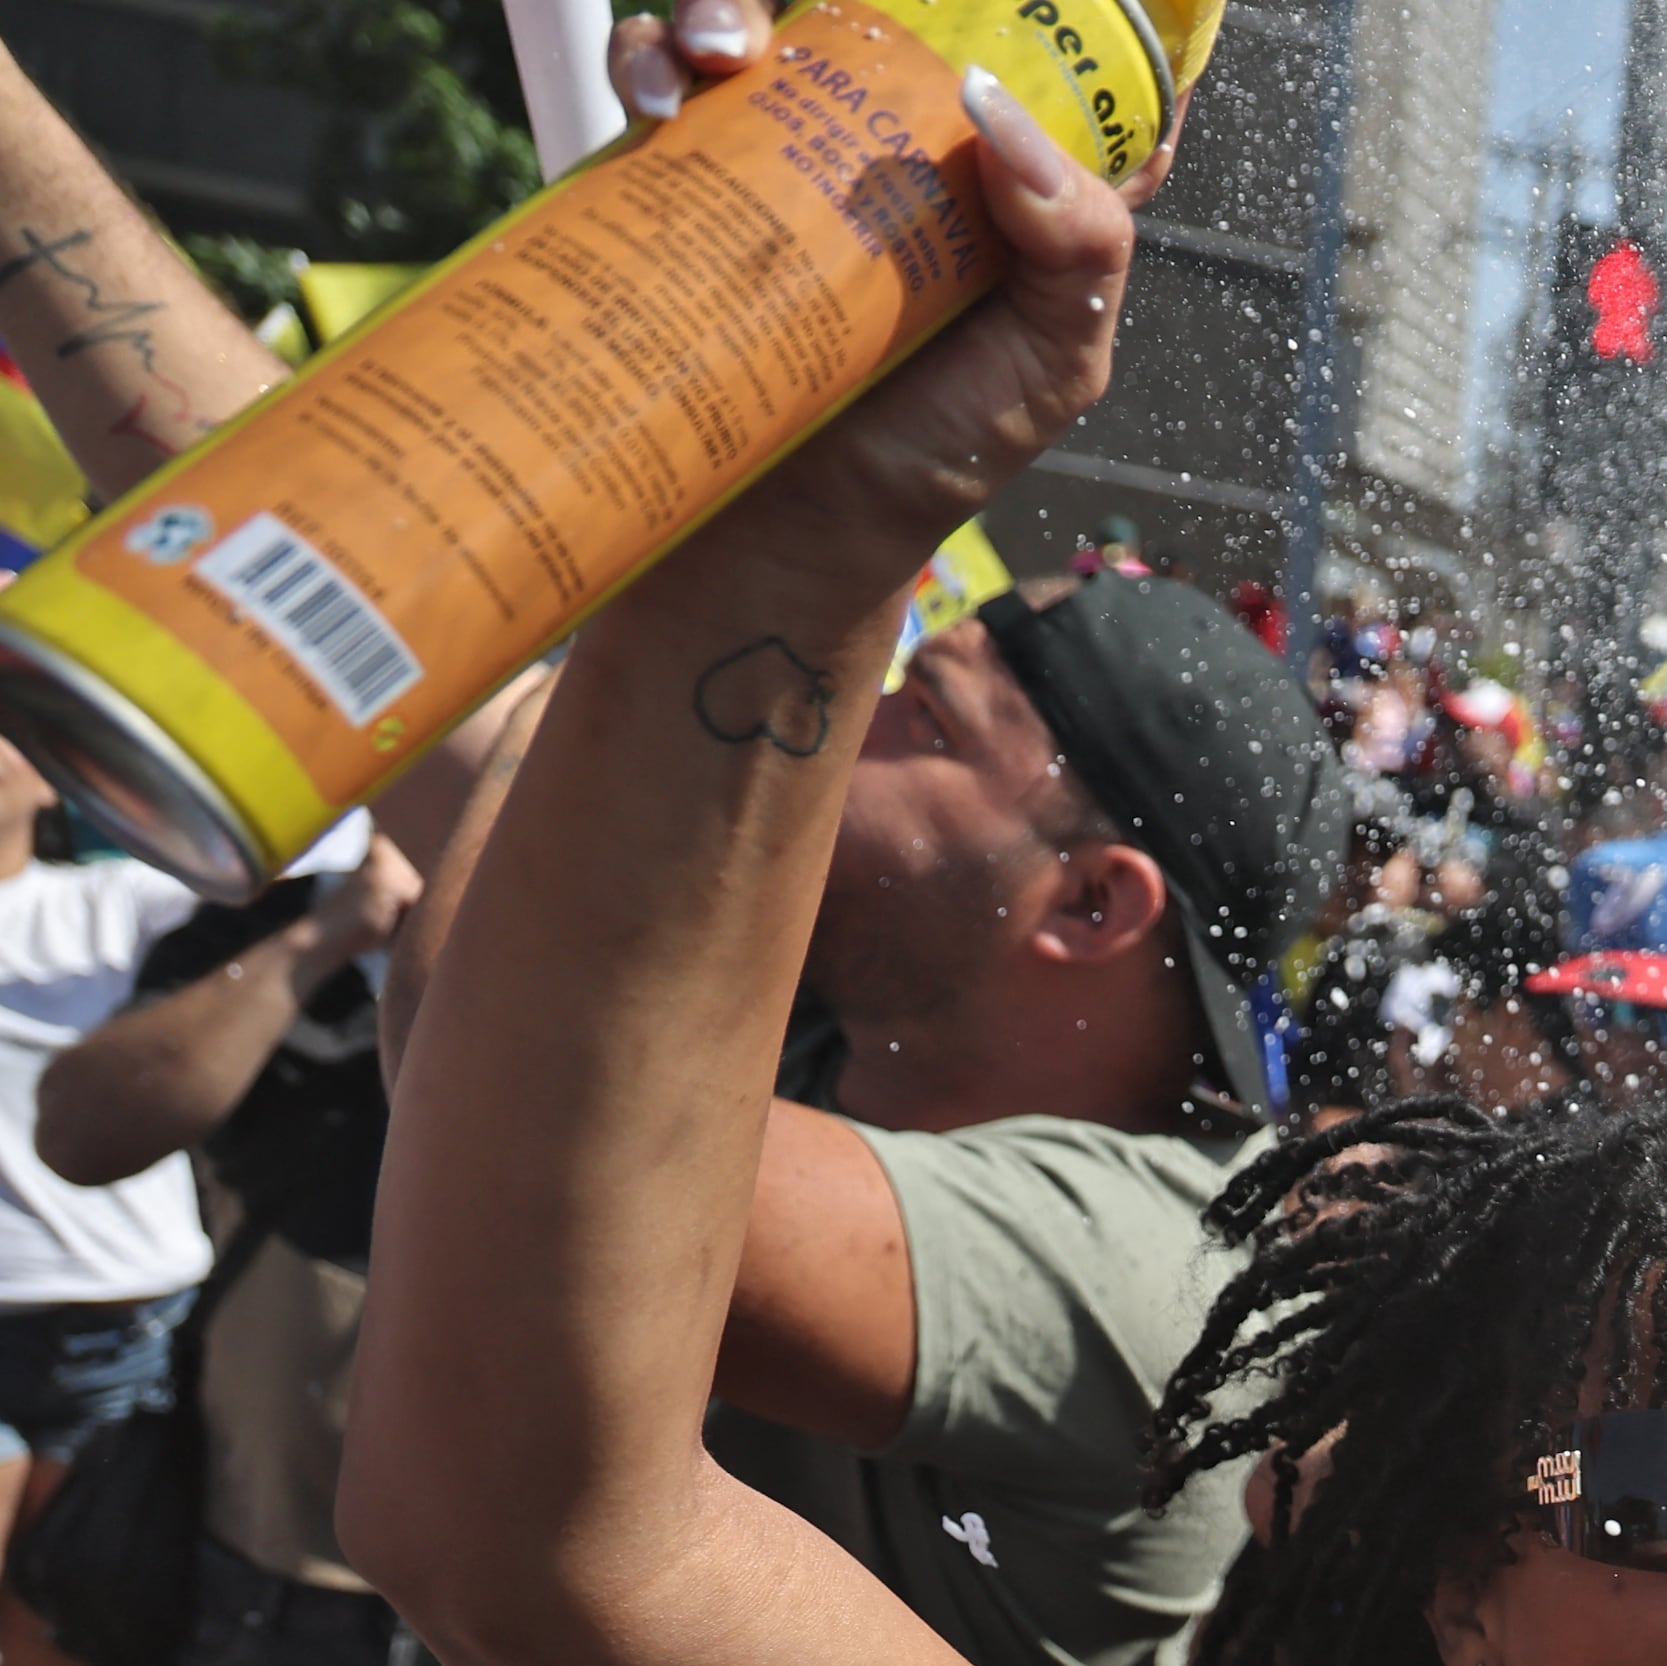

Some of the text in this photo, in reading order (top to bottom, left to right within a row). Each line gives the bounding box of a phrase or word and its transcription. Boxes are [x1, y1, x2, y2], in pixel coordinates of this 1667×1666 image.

[779, 45, 976, 281] PARA CARNAVAL
[805, 132, 868, 195] BOCA
[858, 189, 879, 208] y
[1092, 87, 1136, 177] asia
[767, 76, 801, 102] No
[792, 95, 862, 153] dirigir
[909, 221, 947, 283] sobre
[778, 141, 888, 260] NO INGERIR
[1537, 1450, 1581, 1478] miu
[1538, 1478, 1581, 1505] miu
